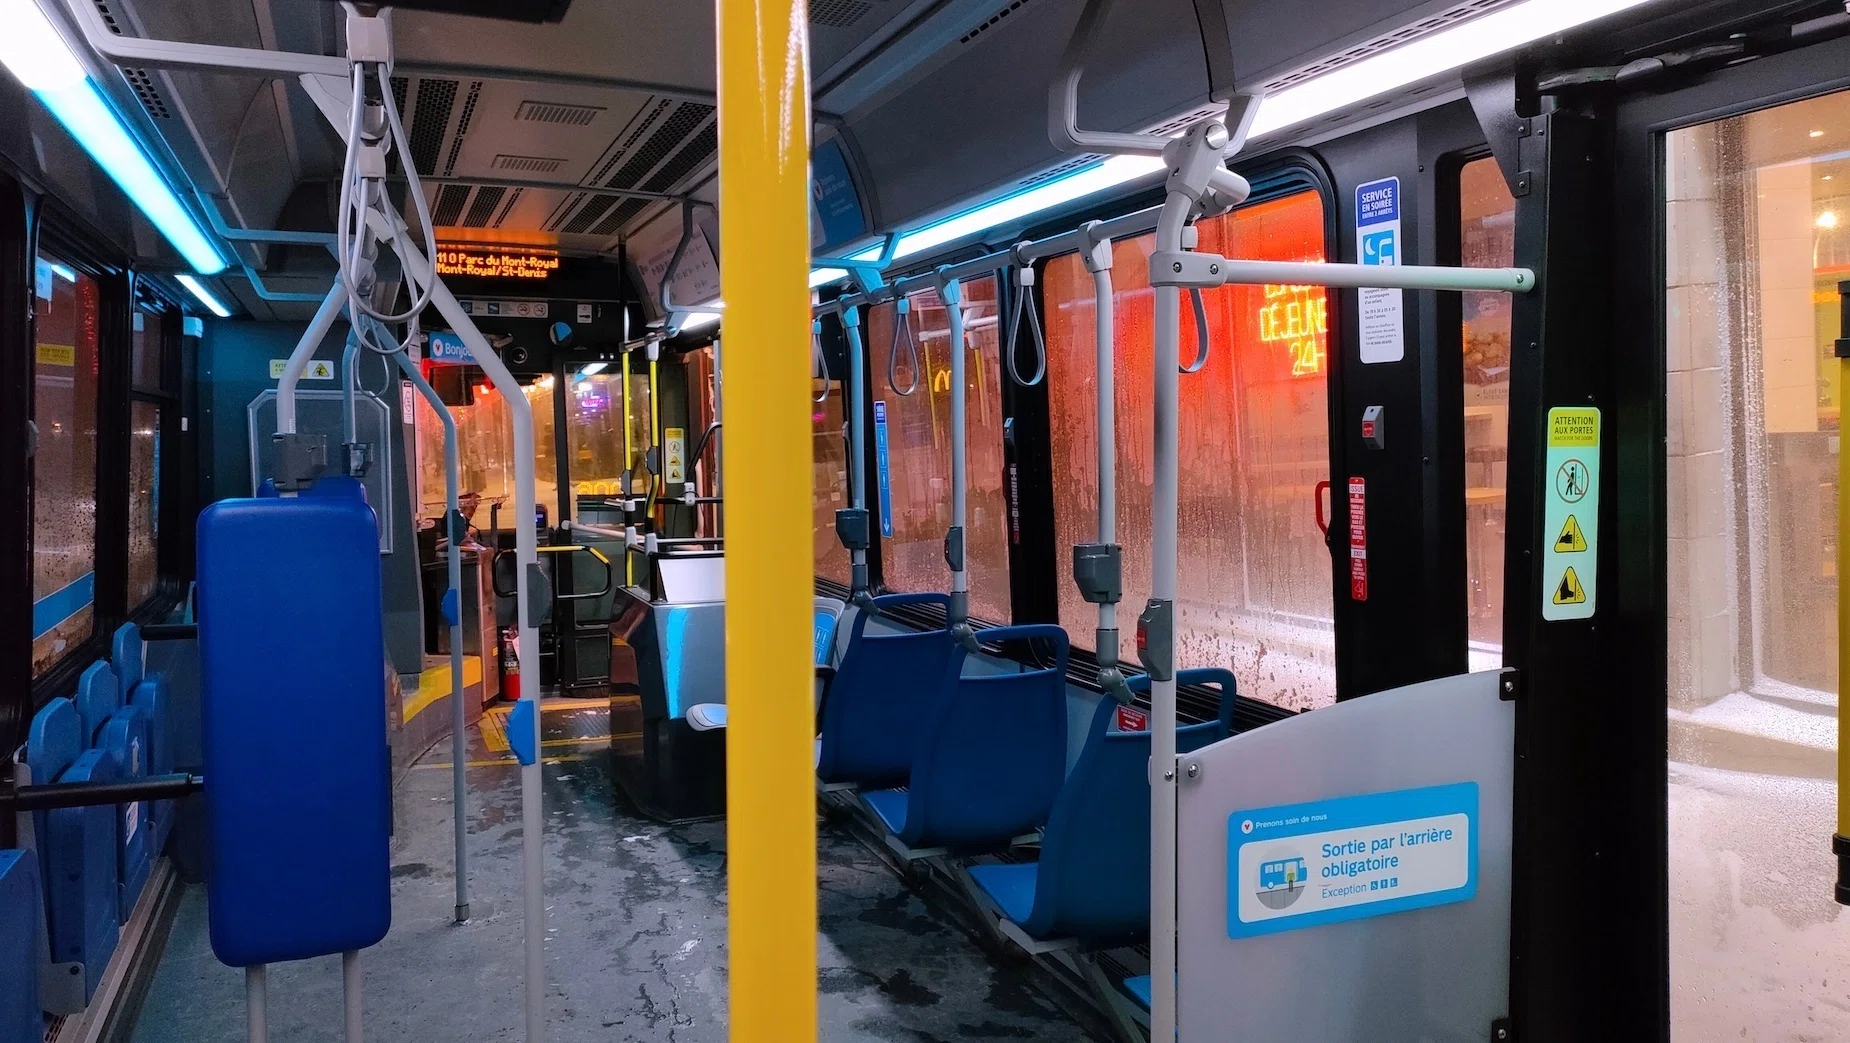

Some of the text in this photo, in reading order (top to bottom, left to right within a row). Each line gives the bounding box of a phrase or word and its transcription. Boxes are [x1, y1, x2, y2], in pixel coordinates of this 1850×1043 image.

[1361, 187, 1393, 204] SERVICE
[1361, 198, 1393, 213] EN SOIRÉE
[458, 253, 484, 265] Parc
[486, 254, 500, 266] du
[501, 255, 559, 269] Mont-Royal
[437, 262, 548, 278] Mont-Royal/St-Denis
[1555, 416, 1594, 425] ATTENTION
[1570, 426, 1593, 434] PORTES
[1255, 813, 1328, 829] Prenons soin de nous
[1322, 828, 1453, 858] Sortie par l'arrière
[1321, 855, 1399, 878] obligatoire
[1322, 883, 1367, 898] Exception
